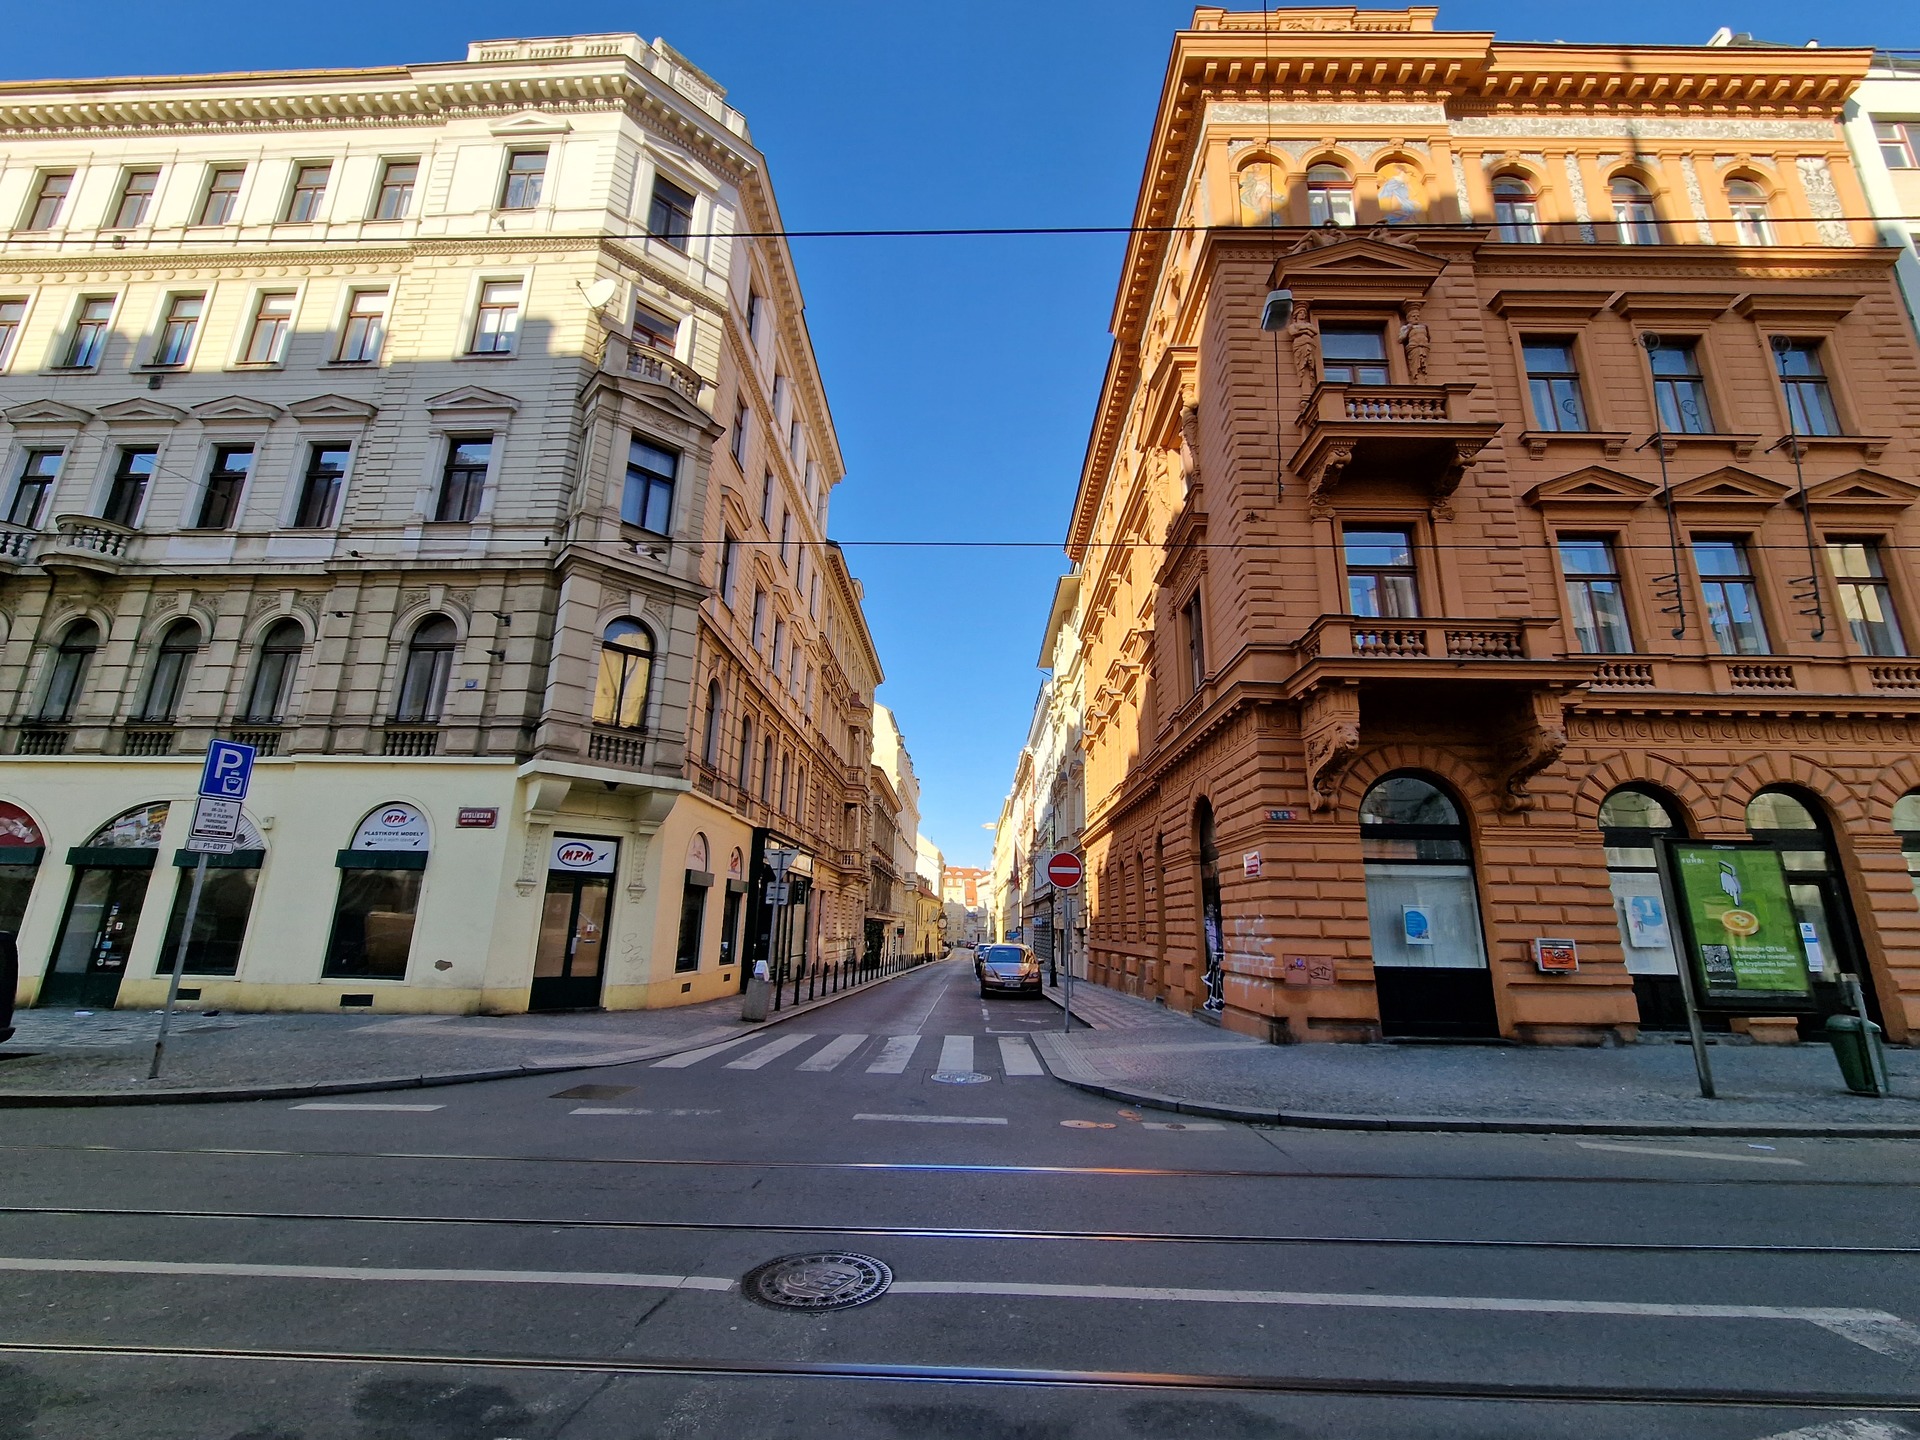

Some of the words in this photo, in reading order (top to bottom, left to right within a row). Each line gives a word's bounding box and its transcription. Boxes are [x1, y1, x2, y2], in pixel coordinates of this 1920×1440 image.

[214, 748, 243, 779] P
[383, 815, 407, 823] MPM
[561, 850, 594, 861] MPM
